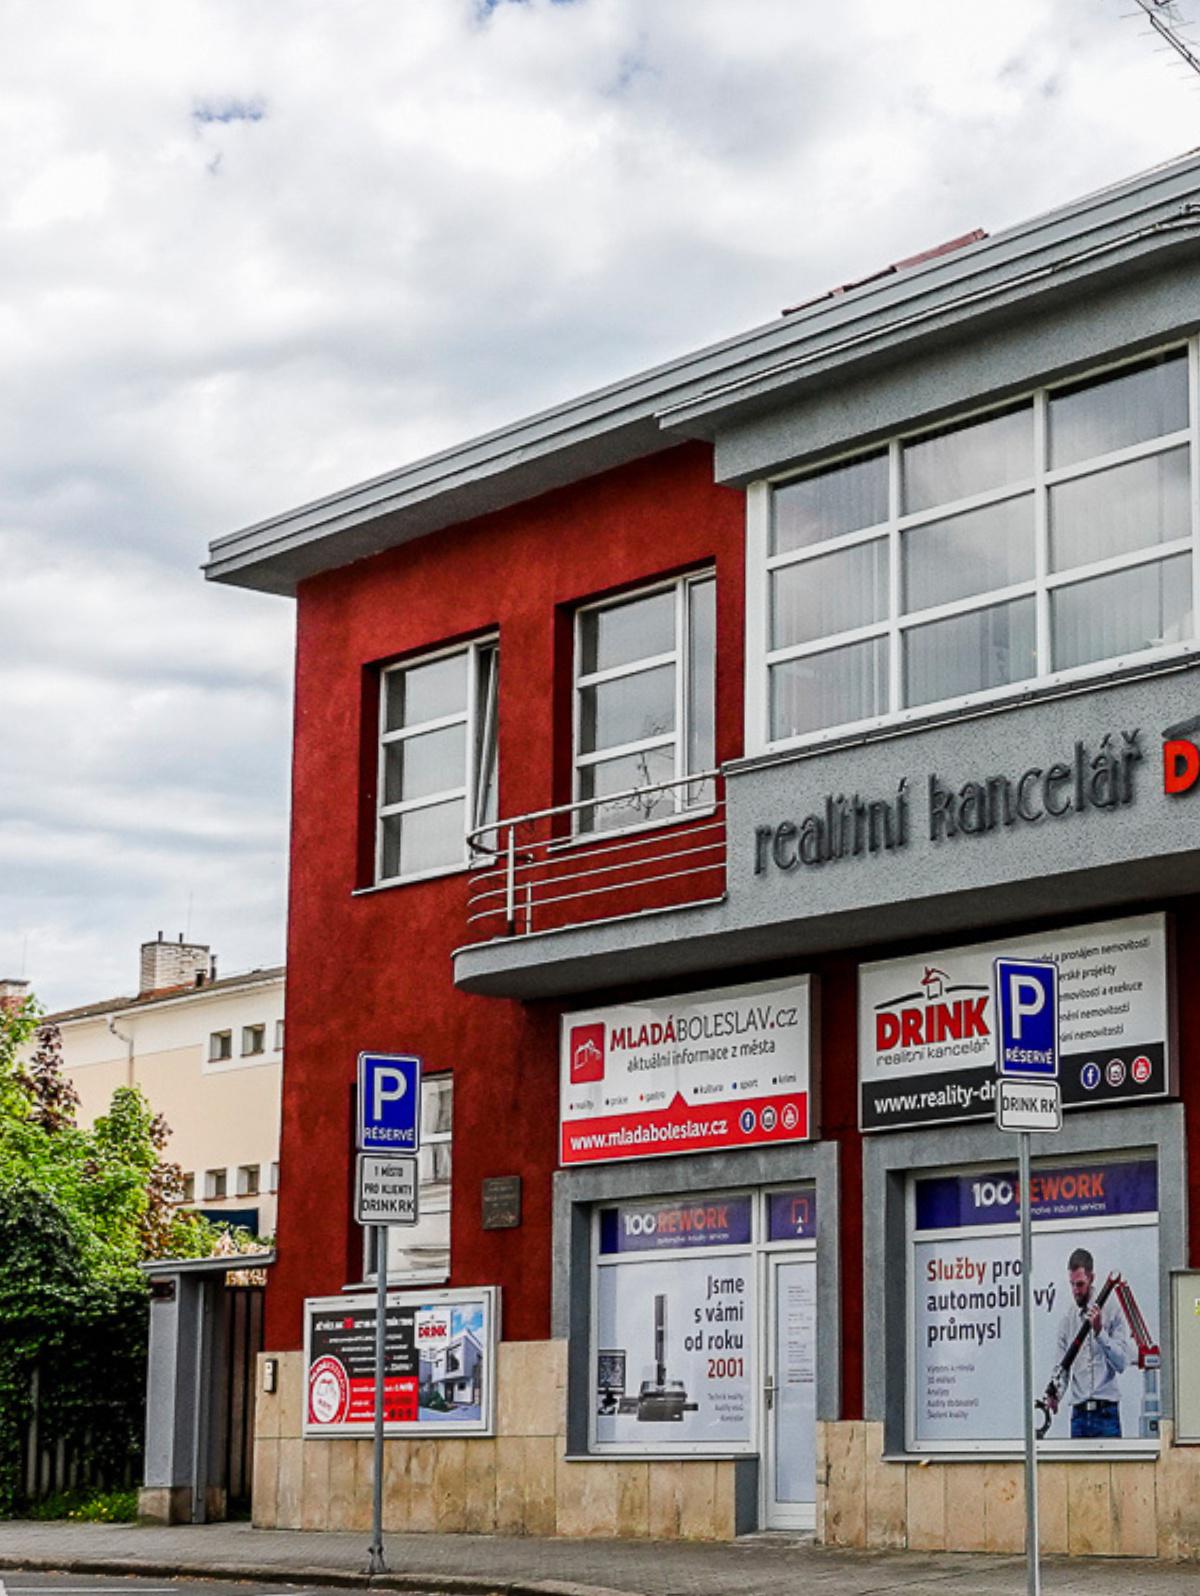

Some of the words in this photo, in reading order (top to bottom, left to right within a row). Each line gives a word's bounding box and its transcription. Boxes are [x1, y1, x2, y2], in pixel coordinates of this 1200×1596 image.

[754, 776, 911, 876] realitní
[928, 728, 1143, 841] kancelář
[1010, 974, 1045, 1039] P
[876, 995, 990, 1052] DRINK
[627, 1051, 671, 1073] aktuální
[672, 1047, 728, 1066] informace
[731, 1046, 738, 1058] z
[740, 1039, 776, 1056] města
[876, 1047, 925, 1067] realitní
[927, 1038, 990, 1059] kancelář
[1005, 1046, 1053, 1064] RÉSERVÉ
[373, 1067, 407, 1121] P
[874, 1080, 997, 1114] www.reality-dr
[1002, 1096, 1039, 1112] DRINK
[1040, 1099, 1057, 1112] RK
[364, 1125, 414, 1141] RÉSERVÉ
[570, 1119, 729, 1150] www.mladaboleslav.cz
[364, 1182, 380, 1194] PRO
[362, 1198, 397, 1212] DRINK
[398, 1199, 414, 1213] RK
[927, 1257, 987, 1286] Služby
[992, 1259, 1022, 1284] pro
[706, 1275, 745, 1300] Jsme
[927, 1281, 1056, 1312] automobilvý
[694, 1308, 702, 1324] s
[705, 1300, 743, 1322] vámi
[684, 1329, 703, 1351] od
[708, 1329, 743, 1350] roku
[927, 1315, 1001, 1348] průmysl
[707, 1356, 743, 1379] 2001
